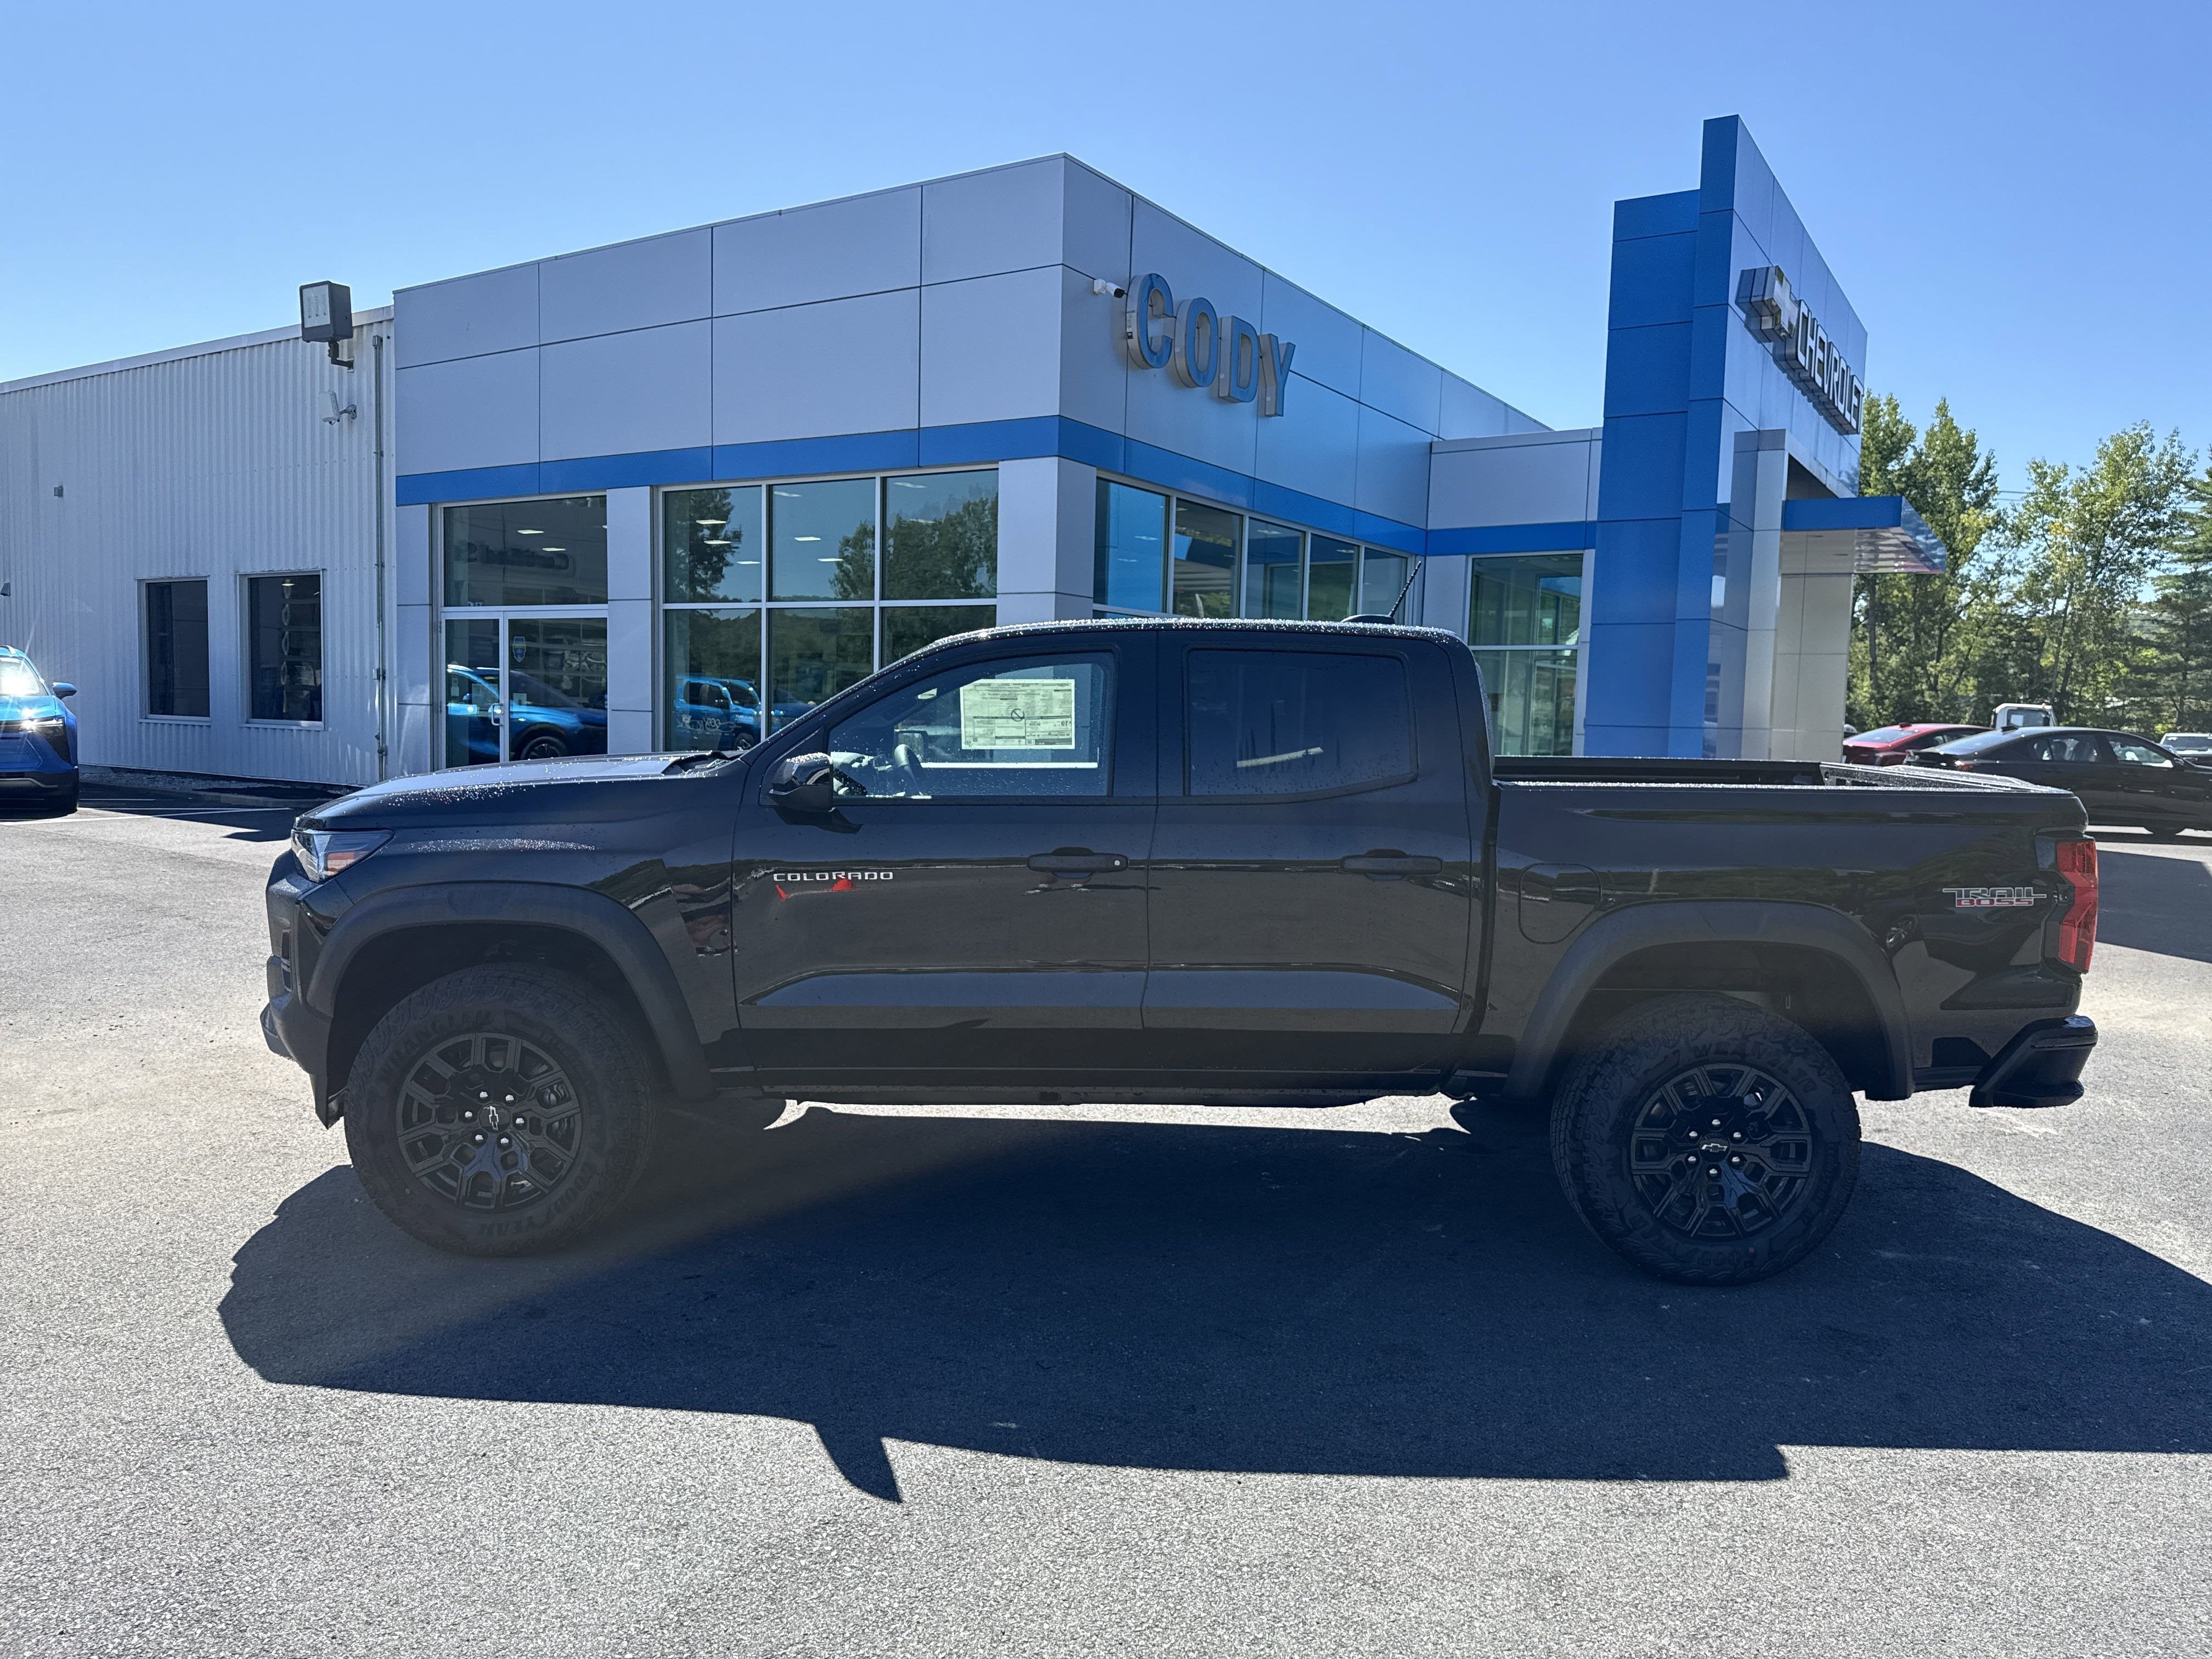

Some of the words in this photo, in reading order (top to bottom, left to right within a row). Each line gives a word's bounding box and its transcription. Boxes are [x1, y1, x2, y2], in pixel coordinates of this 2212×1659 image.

[1126, 273, 1296, 417] CODY
[1797, 299, 1864, 435] CHEVROLET
[773, 871, 894, 882] COLORADO
[1943, 887, 2047, 898] TRAIL
[1956, 898, 2034, 907] BOSS
